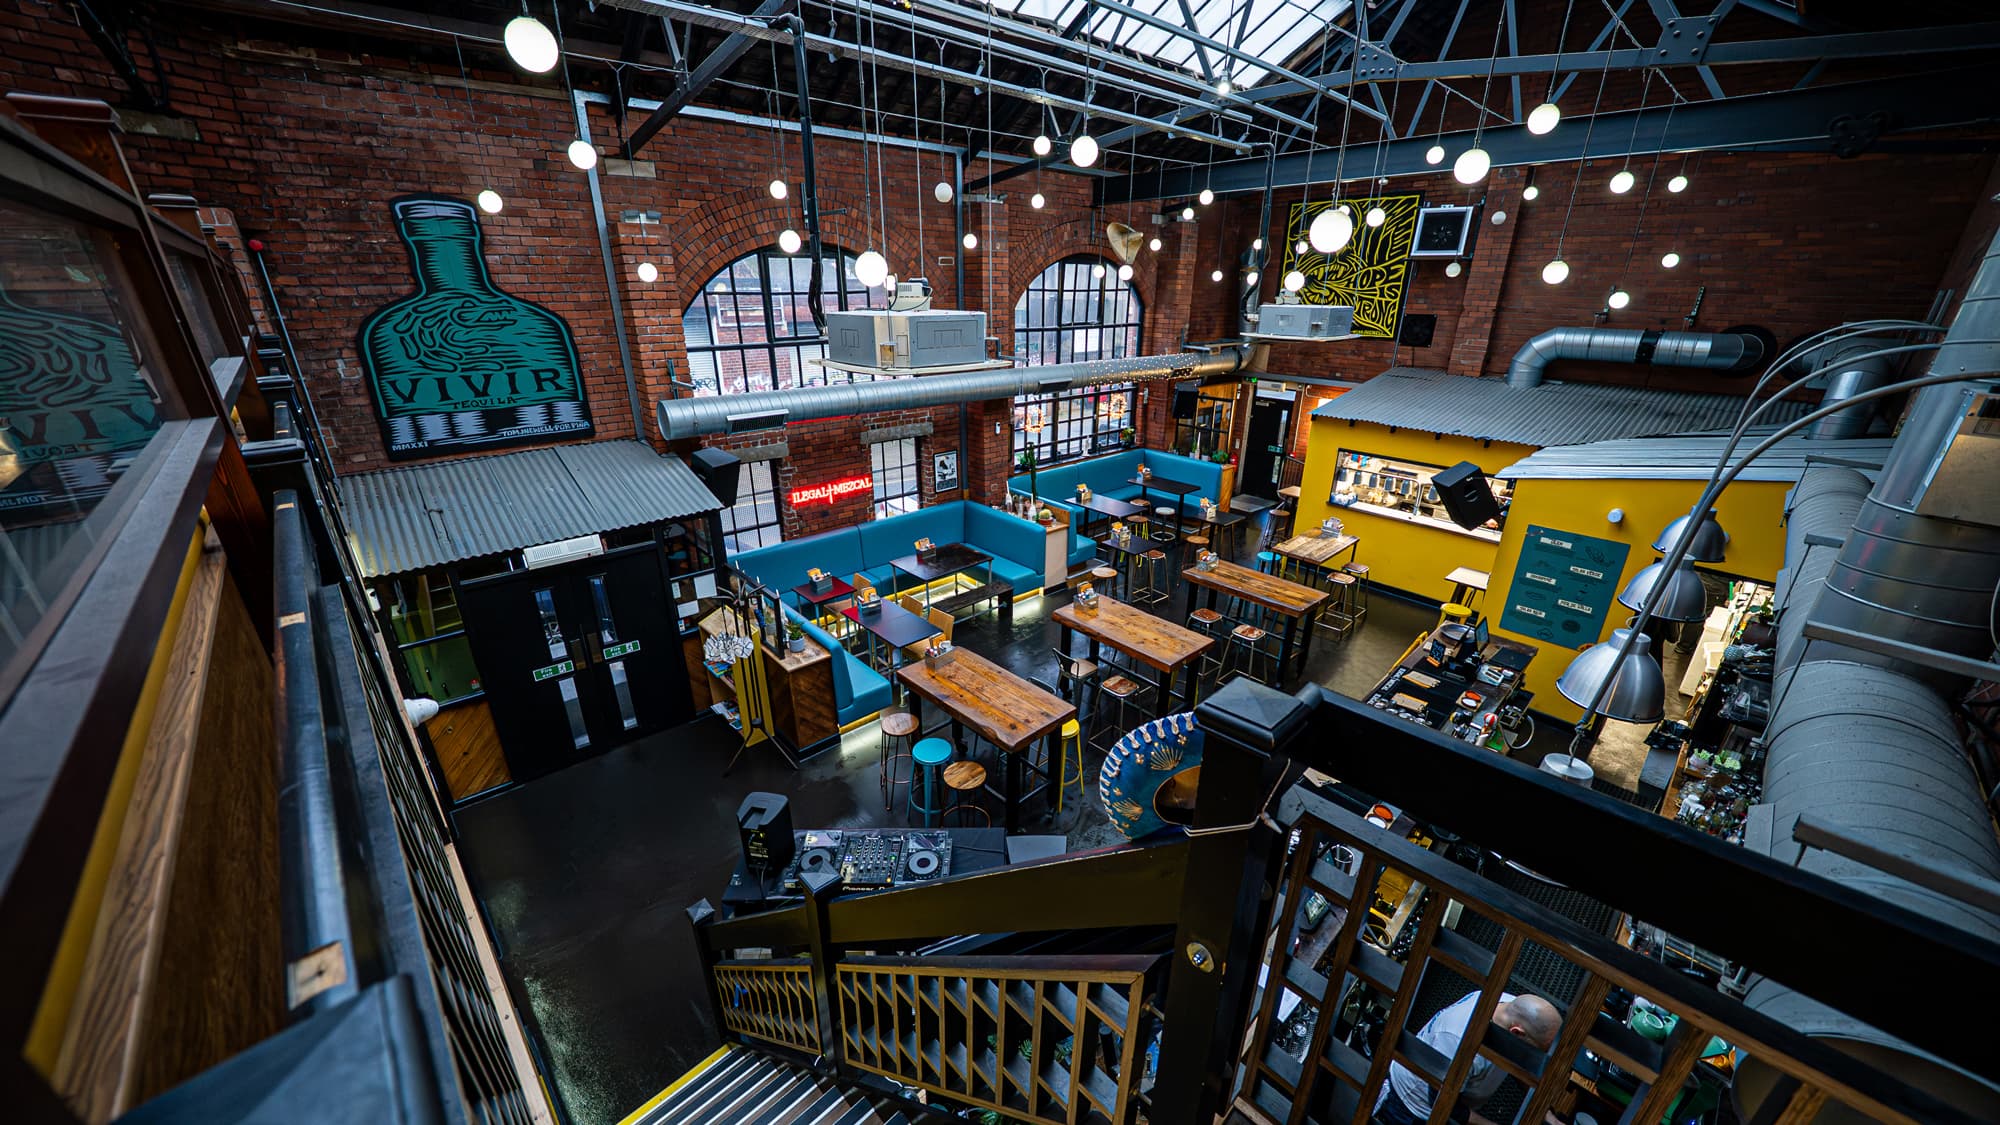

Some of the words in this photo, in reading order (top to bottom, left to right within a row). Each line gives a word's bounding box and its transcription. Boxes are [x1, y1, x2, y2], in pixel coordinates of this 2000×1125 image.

[1346, 263, 1404, 290] HOPE
[1379, 284, 1400, 300] IS
[1354, 295, 1397, 328] TRONG
[386, 367, 570, 404] VIVIR
[452, 396, 519, 410] TEQUILA
[392, 441, 428, 451] MMXXI
[792, 487, 829, 504] ILEGAL
[833, 477, 873, 495] MEZCAL
